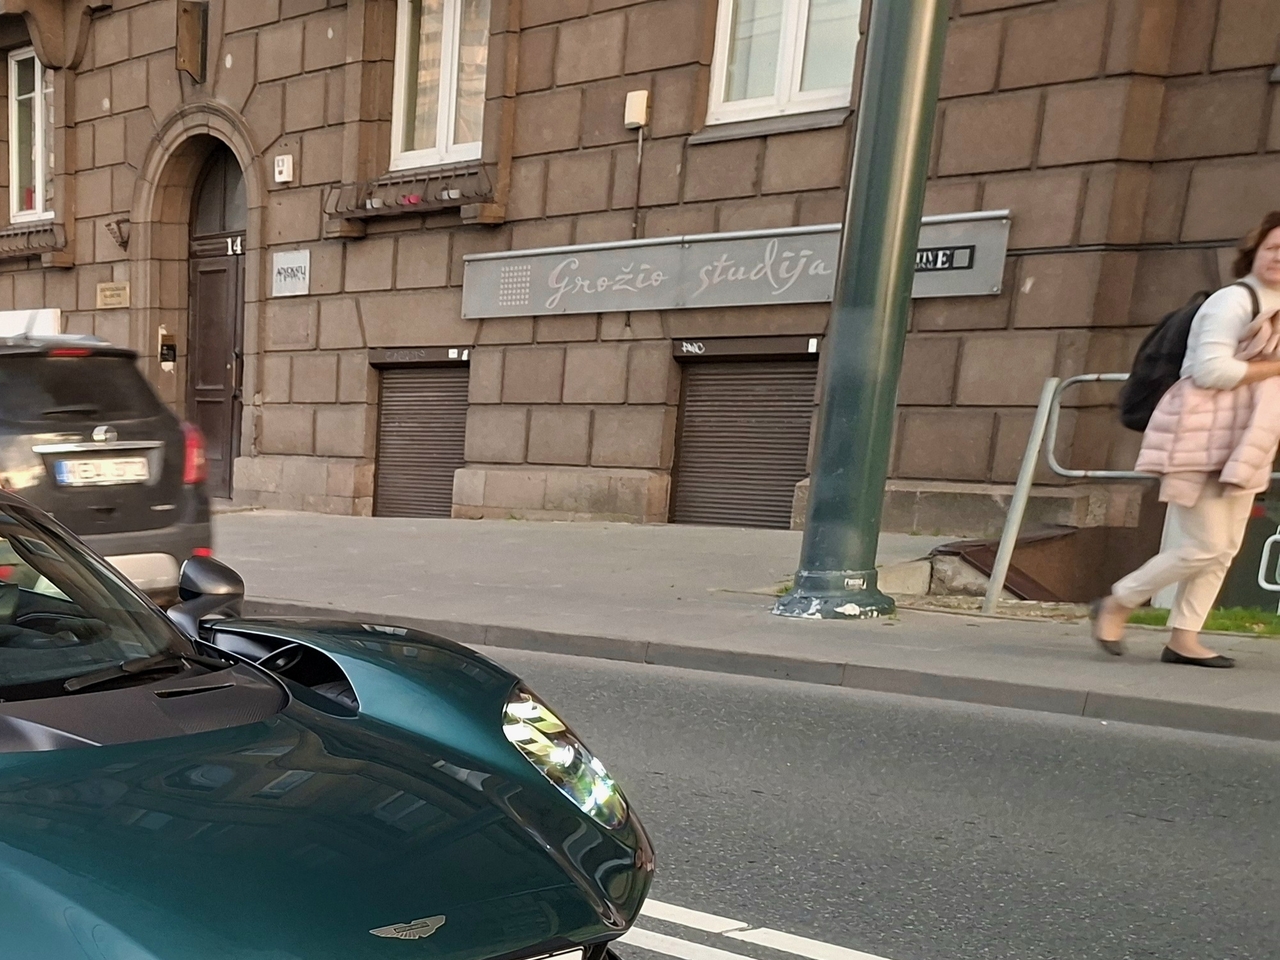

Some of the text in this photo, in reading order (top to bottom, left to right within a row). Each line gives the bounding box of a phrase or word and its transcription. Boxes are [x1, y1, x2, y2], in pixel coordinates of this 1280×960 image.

[226, 236, 242, 255] 14
[546, 238, 833, 309] Grožio studija
